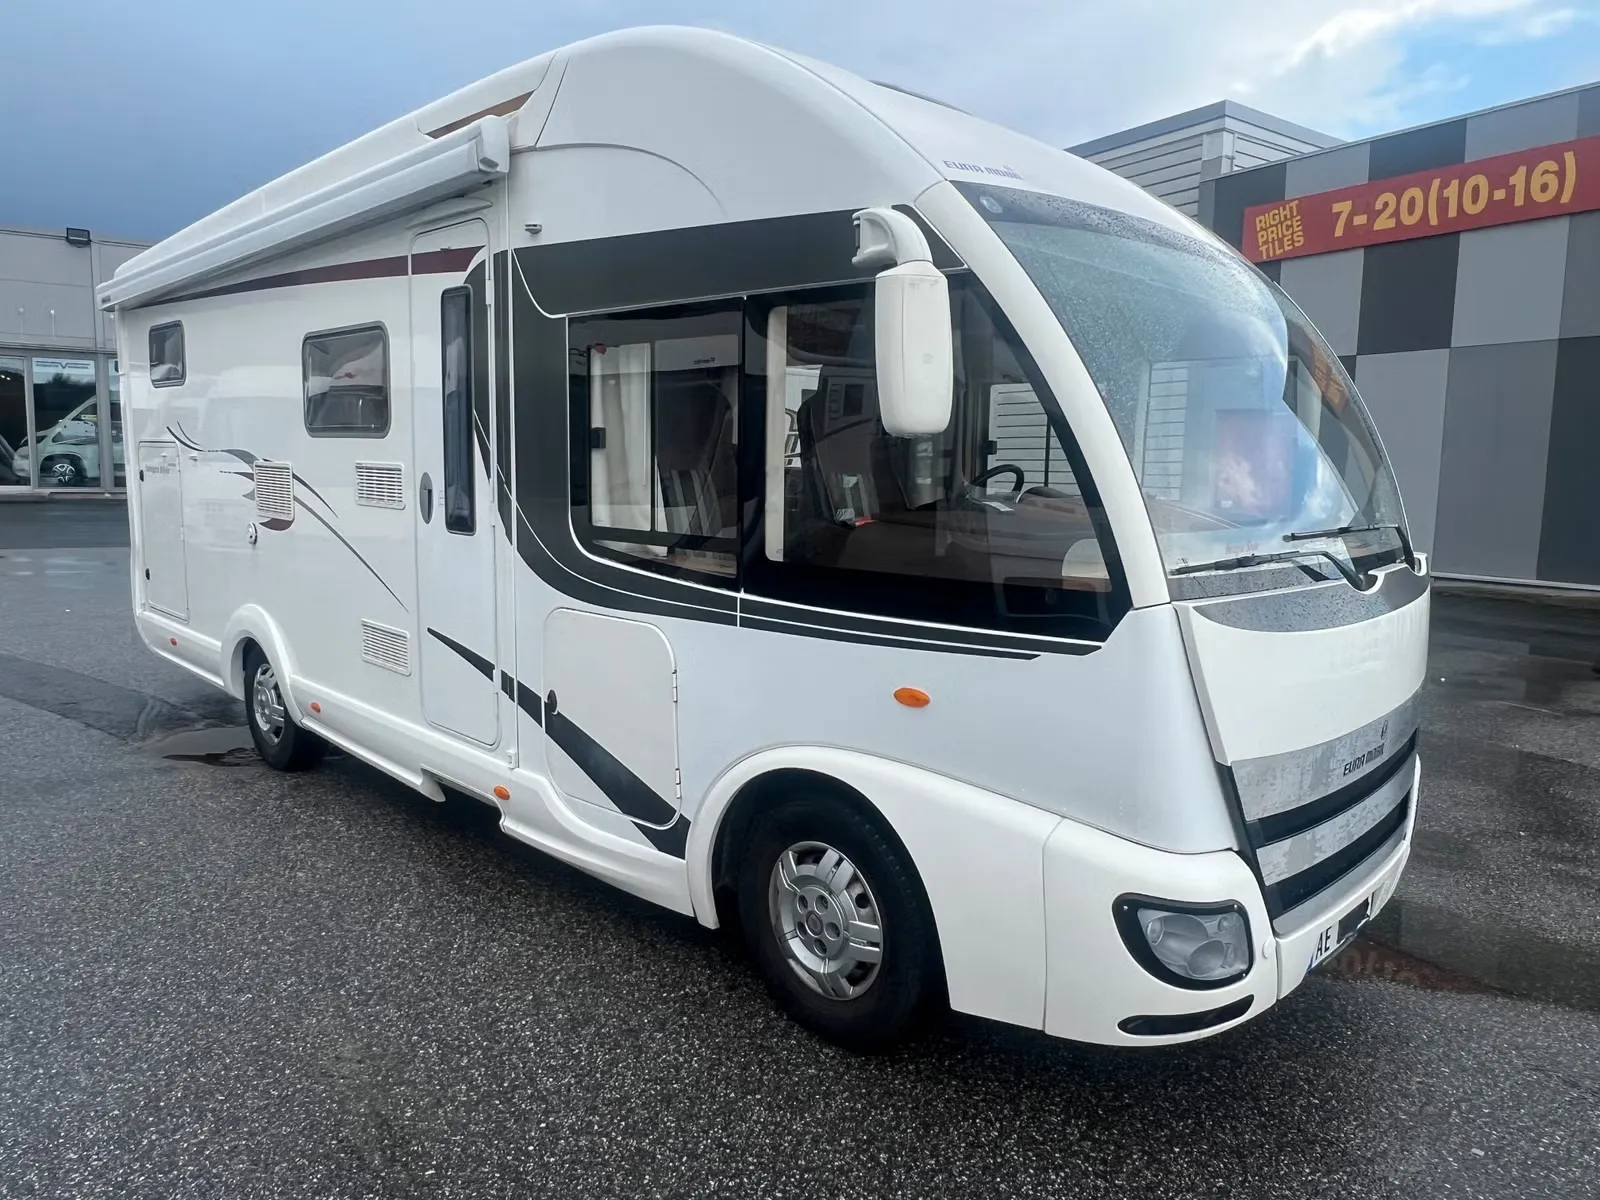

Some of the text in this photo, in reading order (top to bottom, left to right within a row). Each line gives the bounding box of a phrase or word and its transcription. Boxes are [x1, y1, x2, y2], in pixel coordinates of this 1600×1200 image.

[1255, 200, 1299, 231] RIGHT
[1257, 216, 1302, 246] PRICE
[1259, 231, 1304, 259] TILES
[1316, 926, 1332, 960] AE
